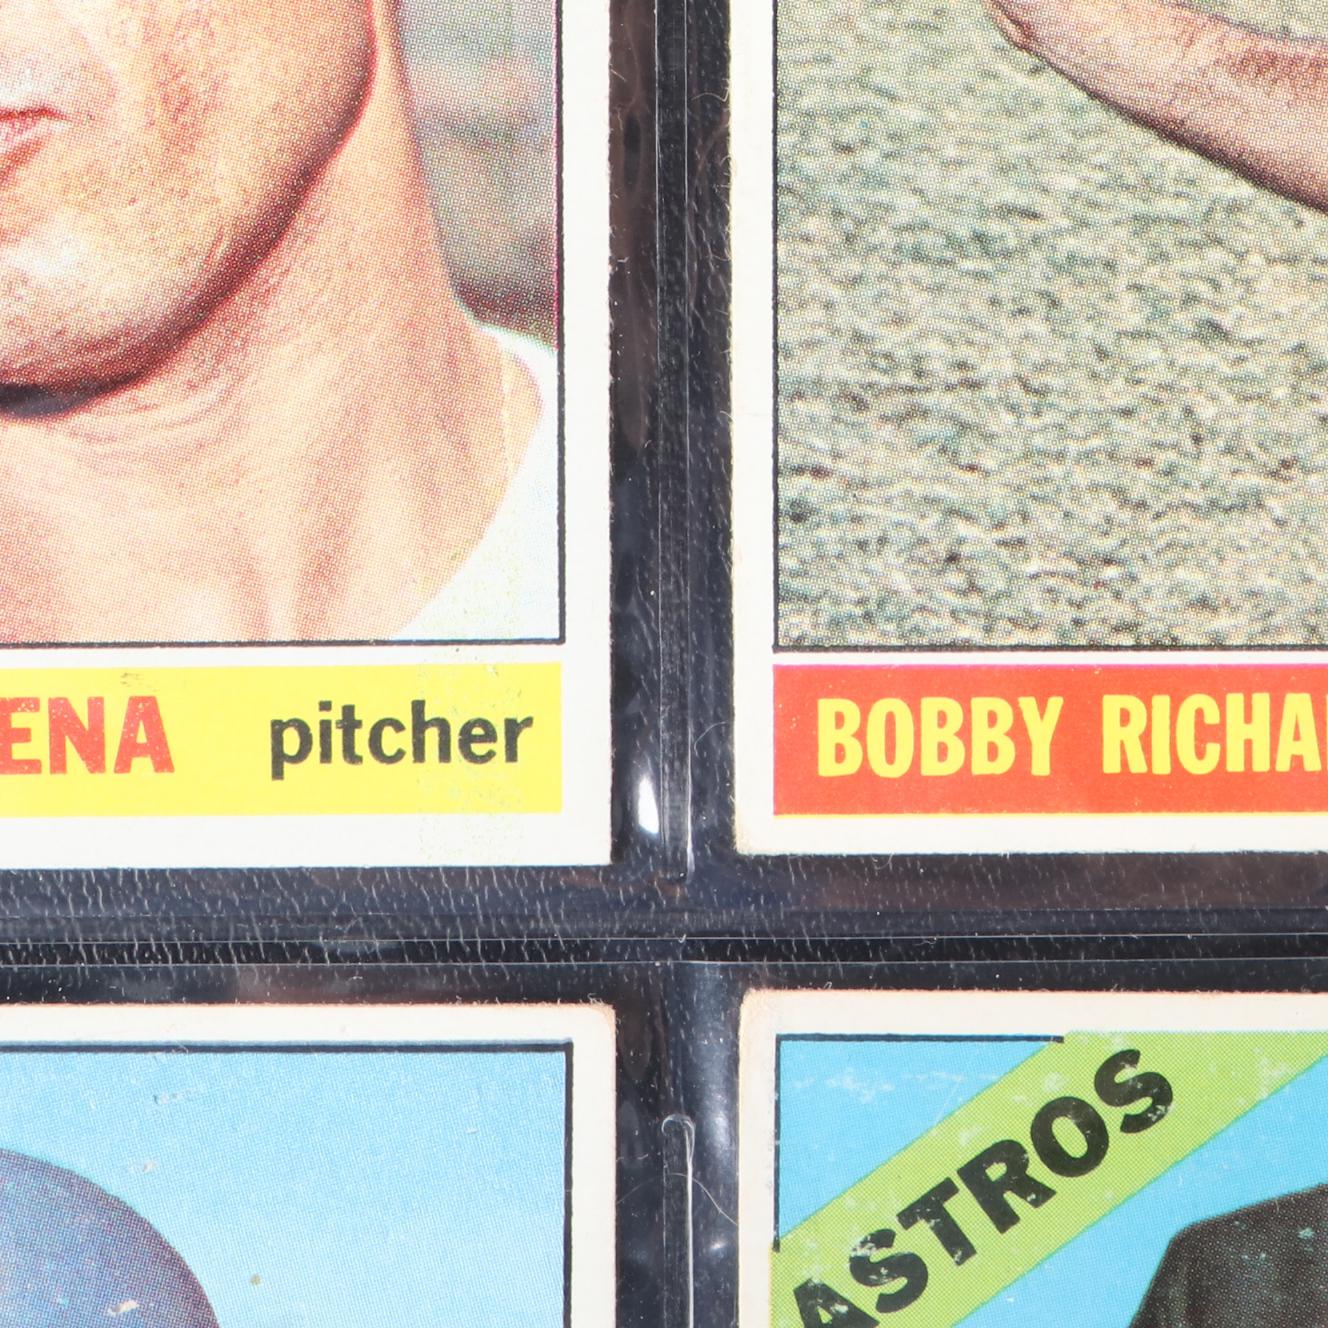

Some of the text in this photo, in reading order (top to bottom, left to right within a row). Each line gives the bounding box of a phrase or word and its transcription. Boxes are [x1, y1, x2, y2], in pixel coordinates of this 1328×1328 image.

[270, 699, 534, 781] pitcher
[816, 696, 1065, 779] BOBBY
[792, 1048, 1175, 1328] ASTROS
